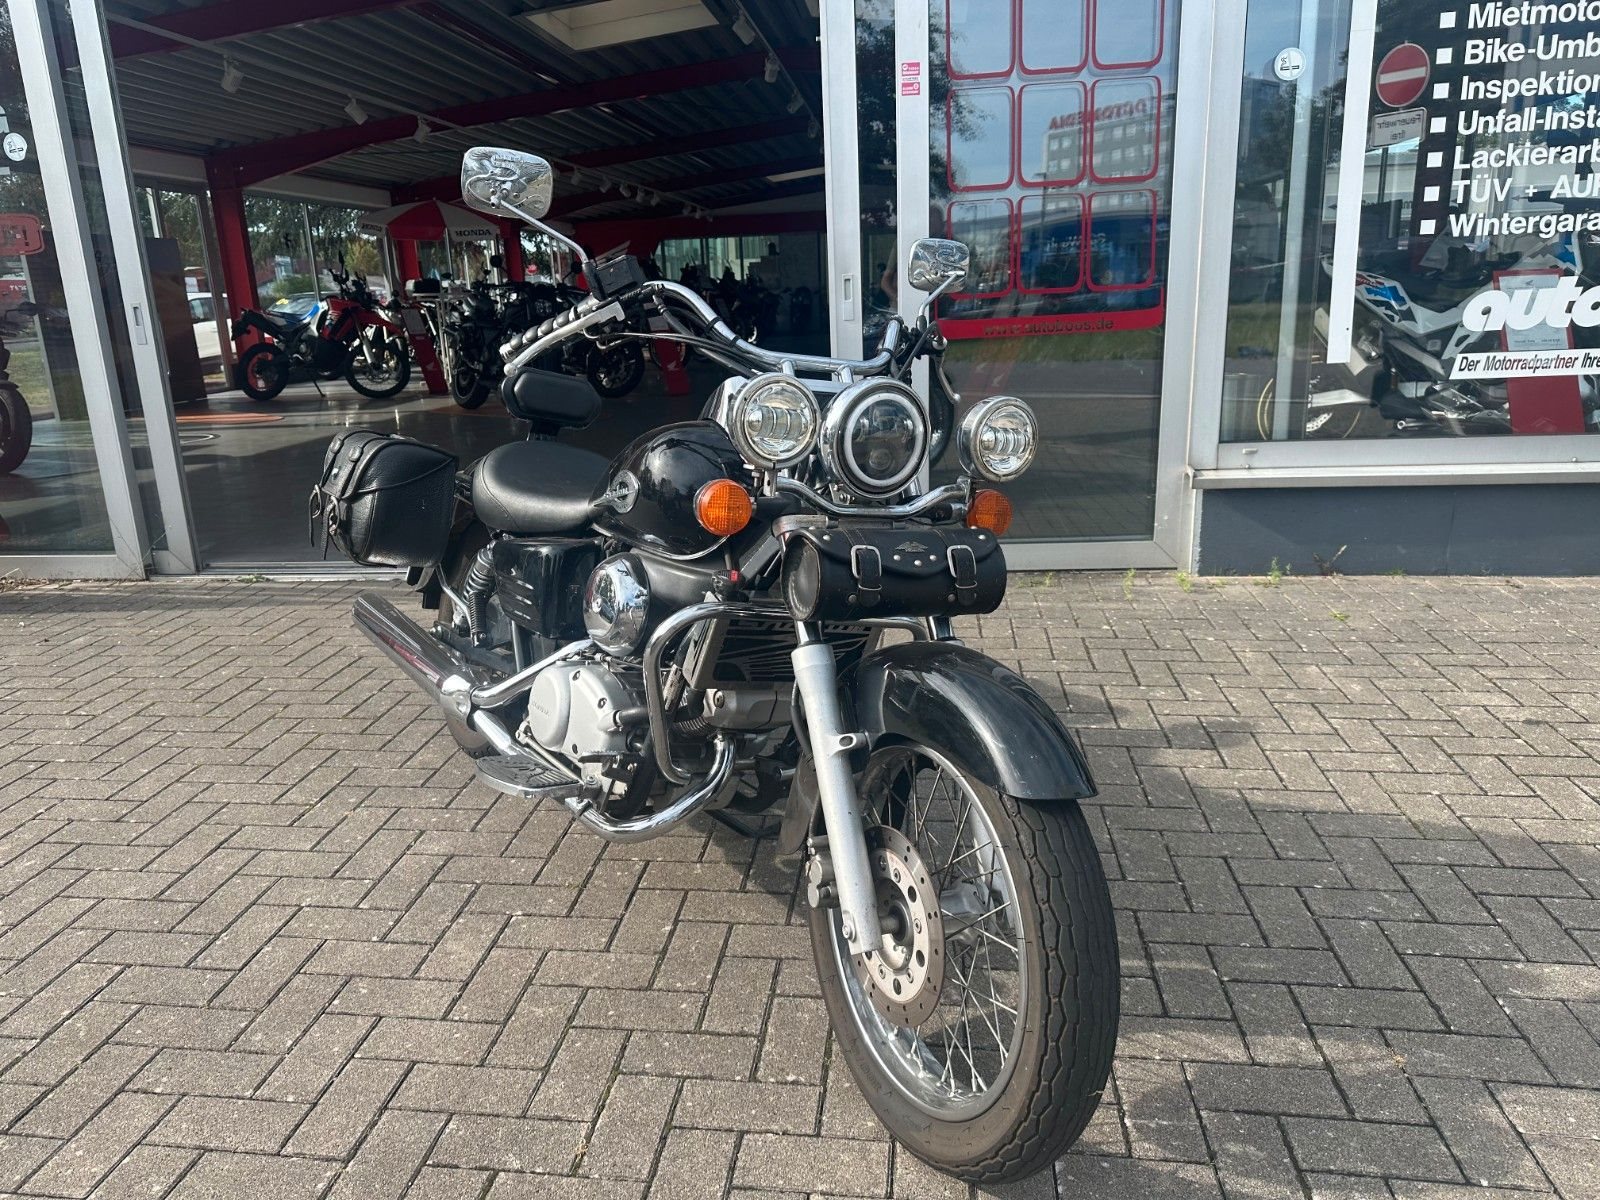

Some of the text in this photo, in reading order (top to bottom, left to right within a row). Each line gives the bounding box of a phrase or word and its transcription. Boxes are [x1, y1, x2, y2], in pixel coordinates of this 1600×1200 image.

[1468, 0, 1600, 29] Mietmoto
[1464, 32, 1600, 65] Bike-Umb
[1458, 105, 1600, 136] Unfall-Inst
[1452, 173, 1513, 204] TÜV
[1525, 184, 1538, 197] +
[455, 229, 492, 237] HONDA
[1449, 212, 1600, 239] Wintergara
[1462, 275, 1600, 332] auto
[1458, 356, 1481, 372] Der
[1483, 354, 1579, 374] Motorradpartner
